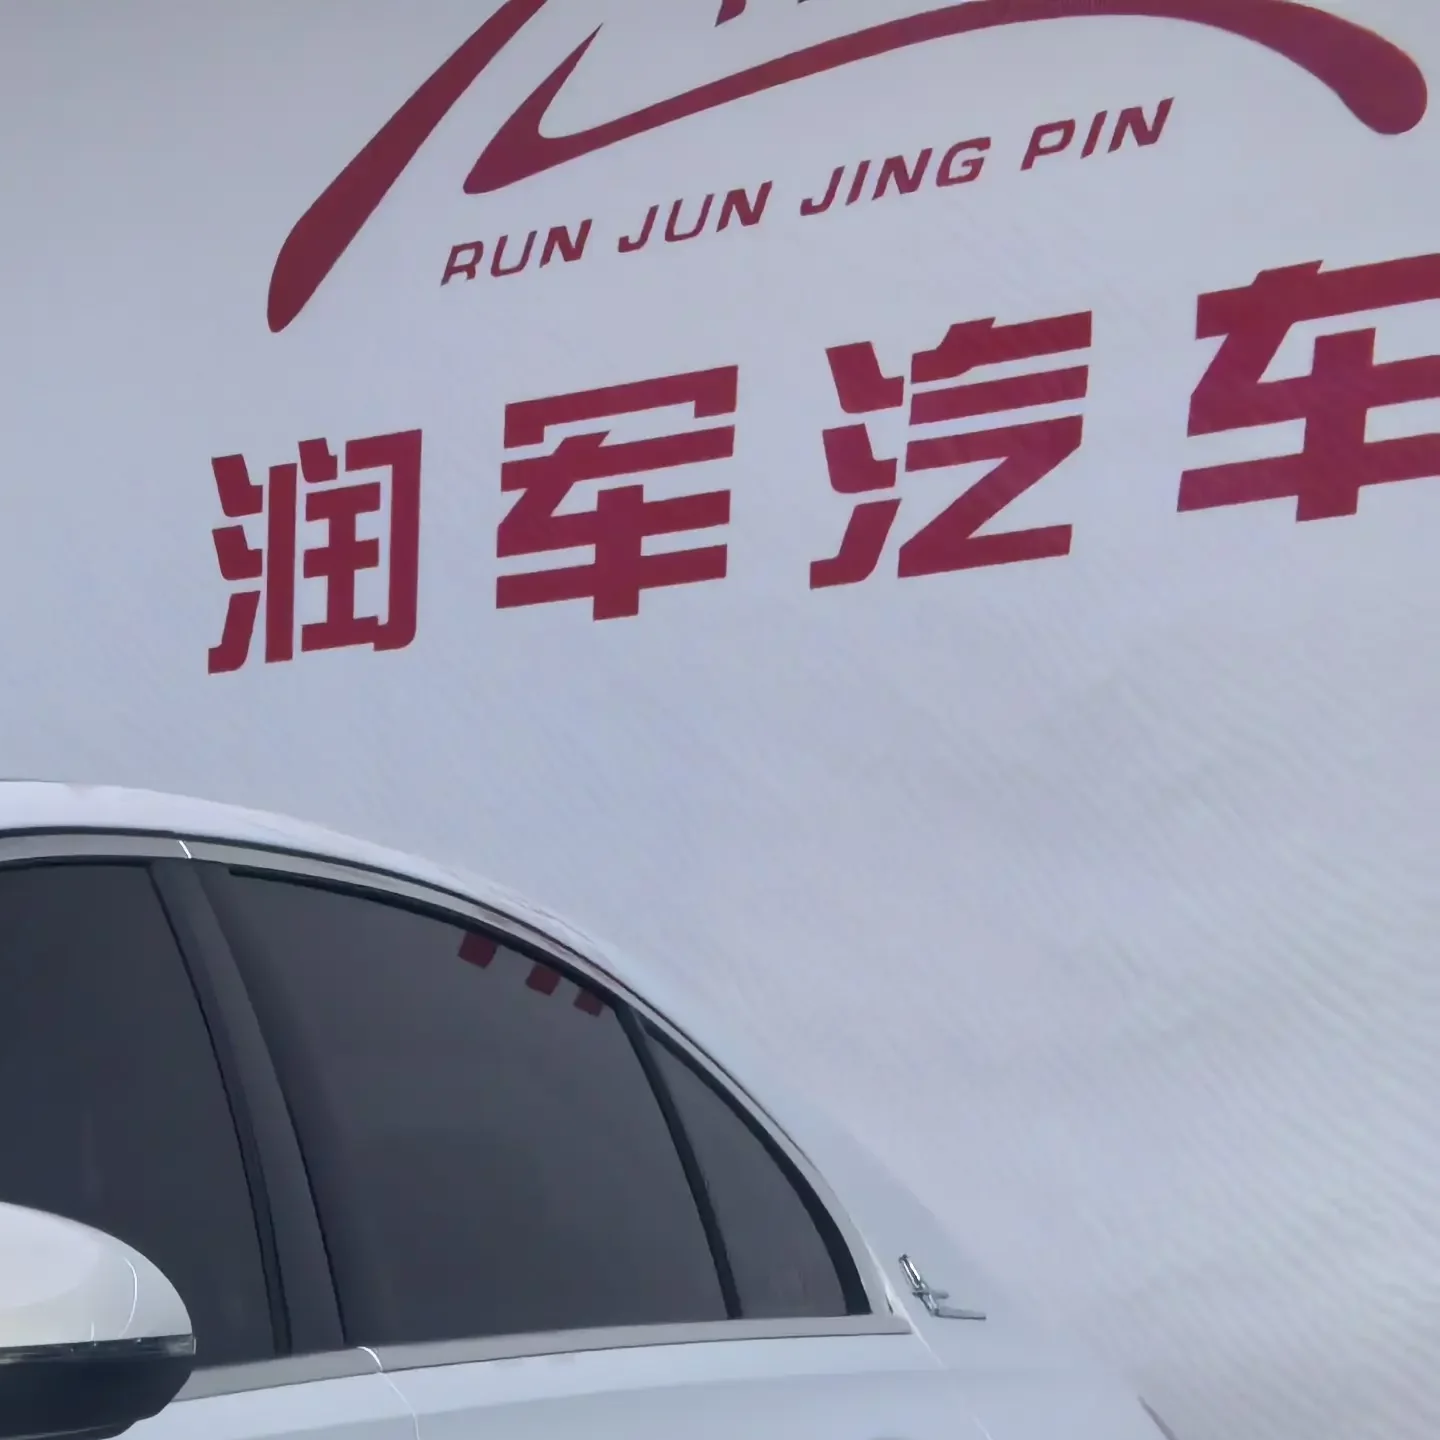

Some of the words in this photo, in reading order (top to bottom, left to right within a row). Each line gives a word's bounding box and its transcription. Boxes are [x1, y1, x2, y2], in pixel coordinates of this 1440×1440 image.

[440, 218, 592, 287] RUN
[617, 181, 773, 254] JUN
[799, 135, 992, 217] JING
[1020, 95, 1175, 171] PIN
[206, 252, 1440, 676] 润军汽车
